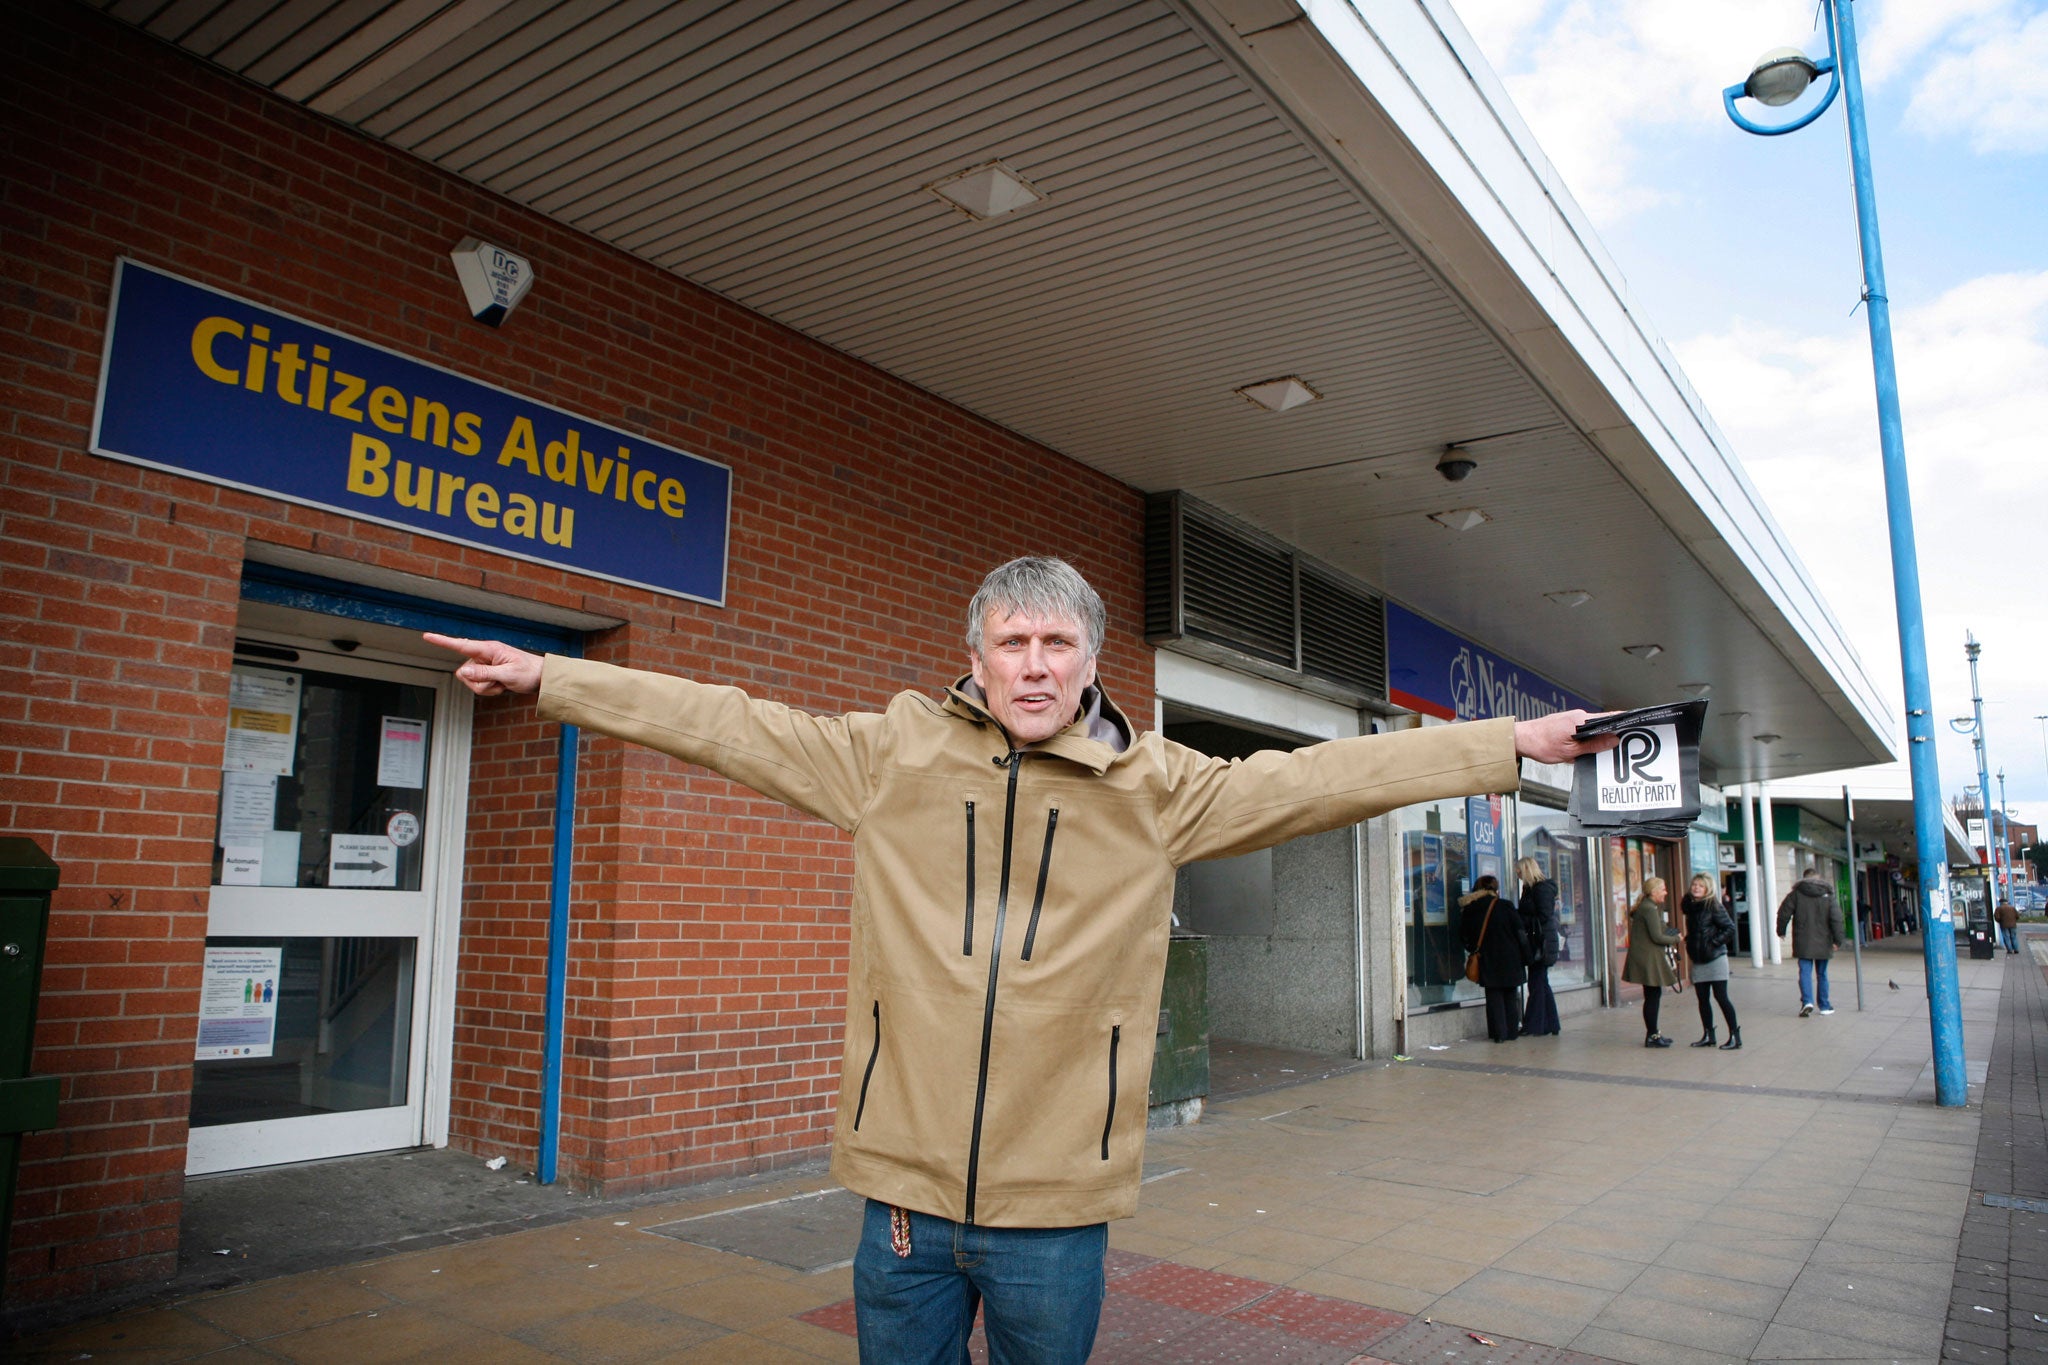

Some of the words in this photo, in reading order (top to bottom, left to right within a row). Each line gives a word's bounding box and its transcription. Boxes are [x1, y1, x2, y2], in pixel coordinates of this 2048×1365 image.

[493, 251, 519, 279] DC
[191, 316, 482, 457] Citizens
[497, 415, 686, 518] Advice
[347, 432, 575, 549] Bureau
[1602, 786, 1641, 804] REALITY
[1645, 784, 1676, 802] PARTY
[1473, 820, 1494, 844] CASH
